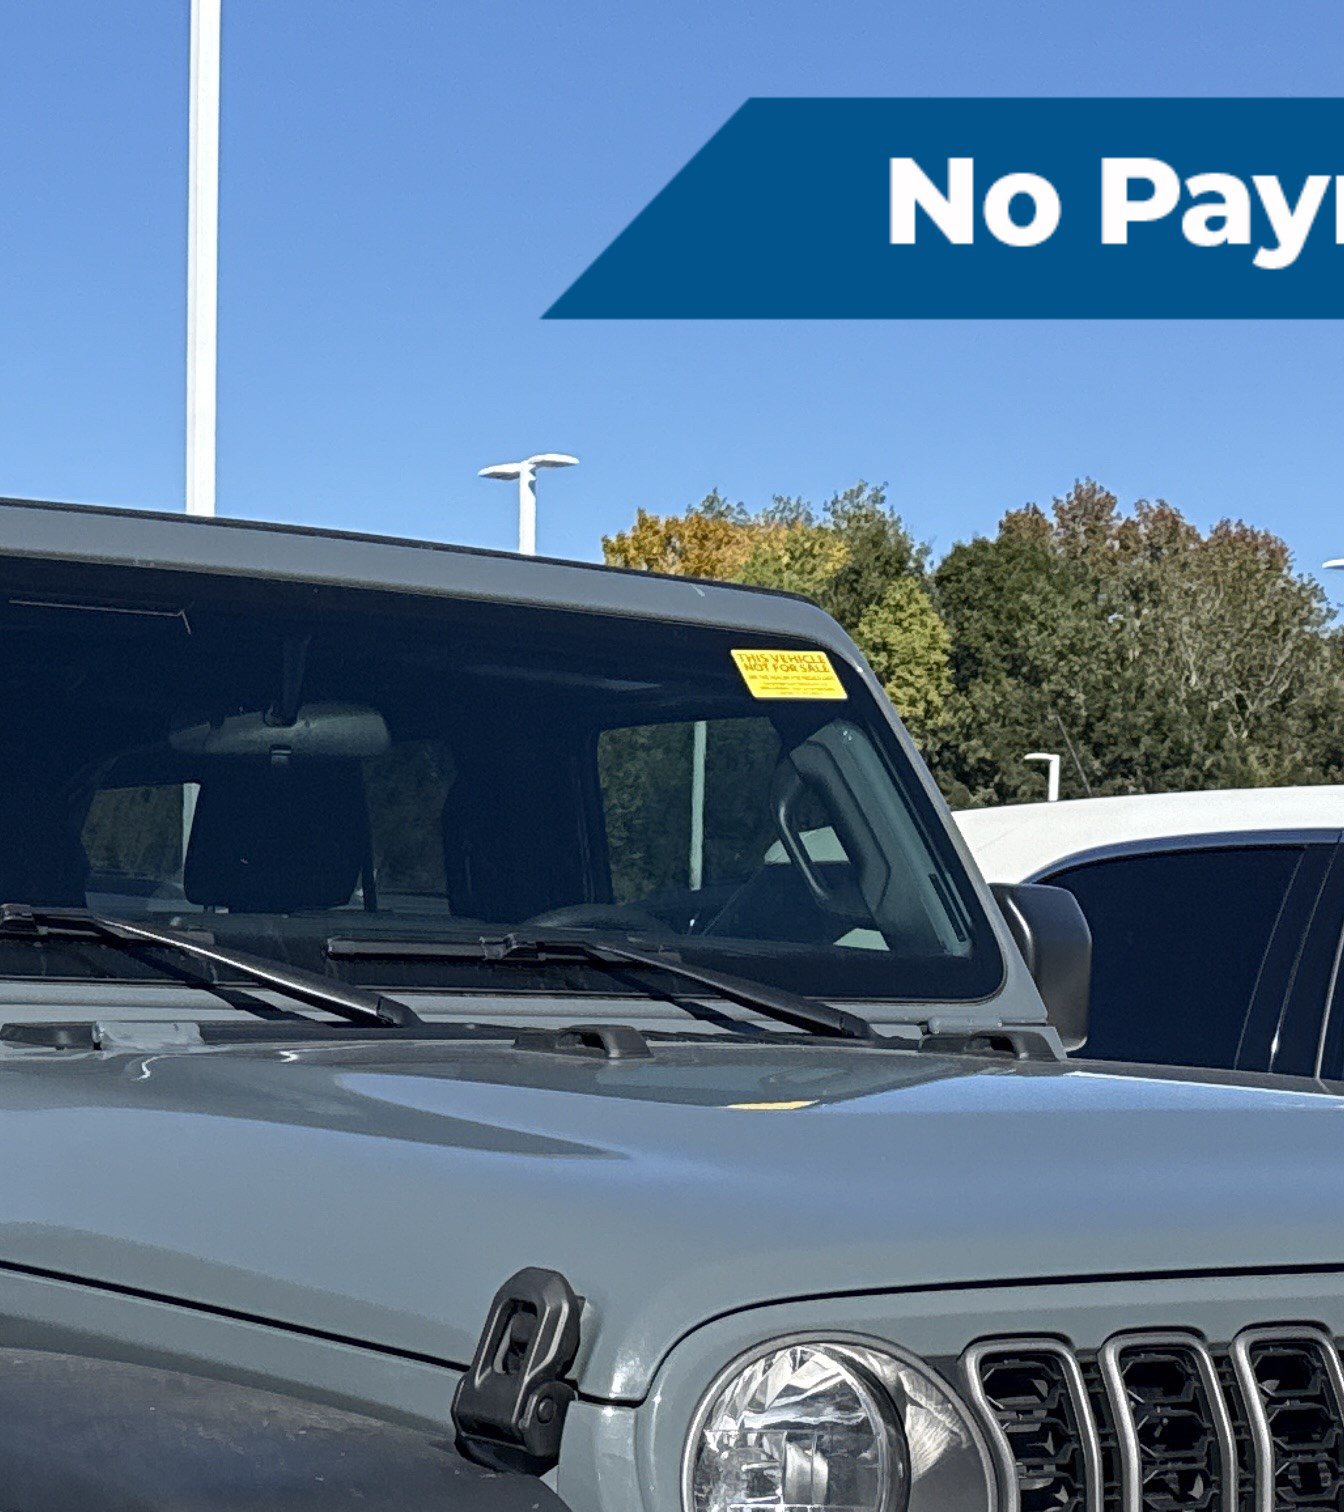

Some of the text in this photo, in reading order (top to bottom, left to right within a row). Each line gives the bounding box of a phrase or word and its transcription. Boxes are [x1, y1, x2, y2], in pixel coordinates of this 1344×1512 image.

[736, 653, 826, 664] THIS VEHICLE
[744, 663, 830, 673] NOT FOR SALE
